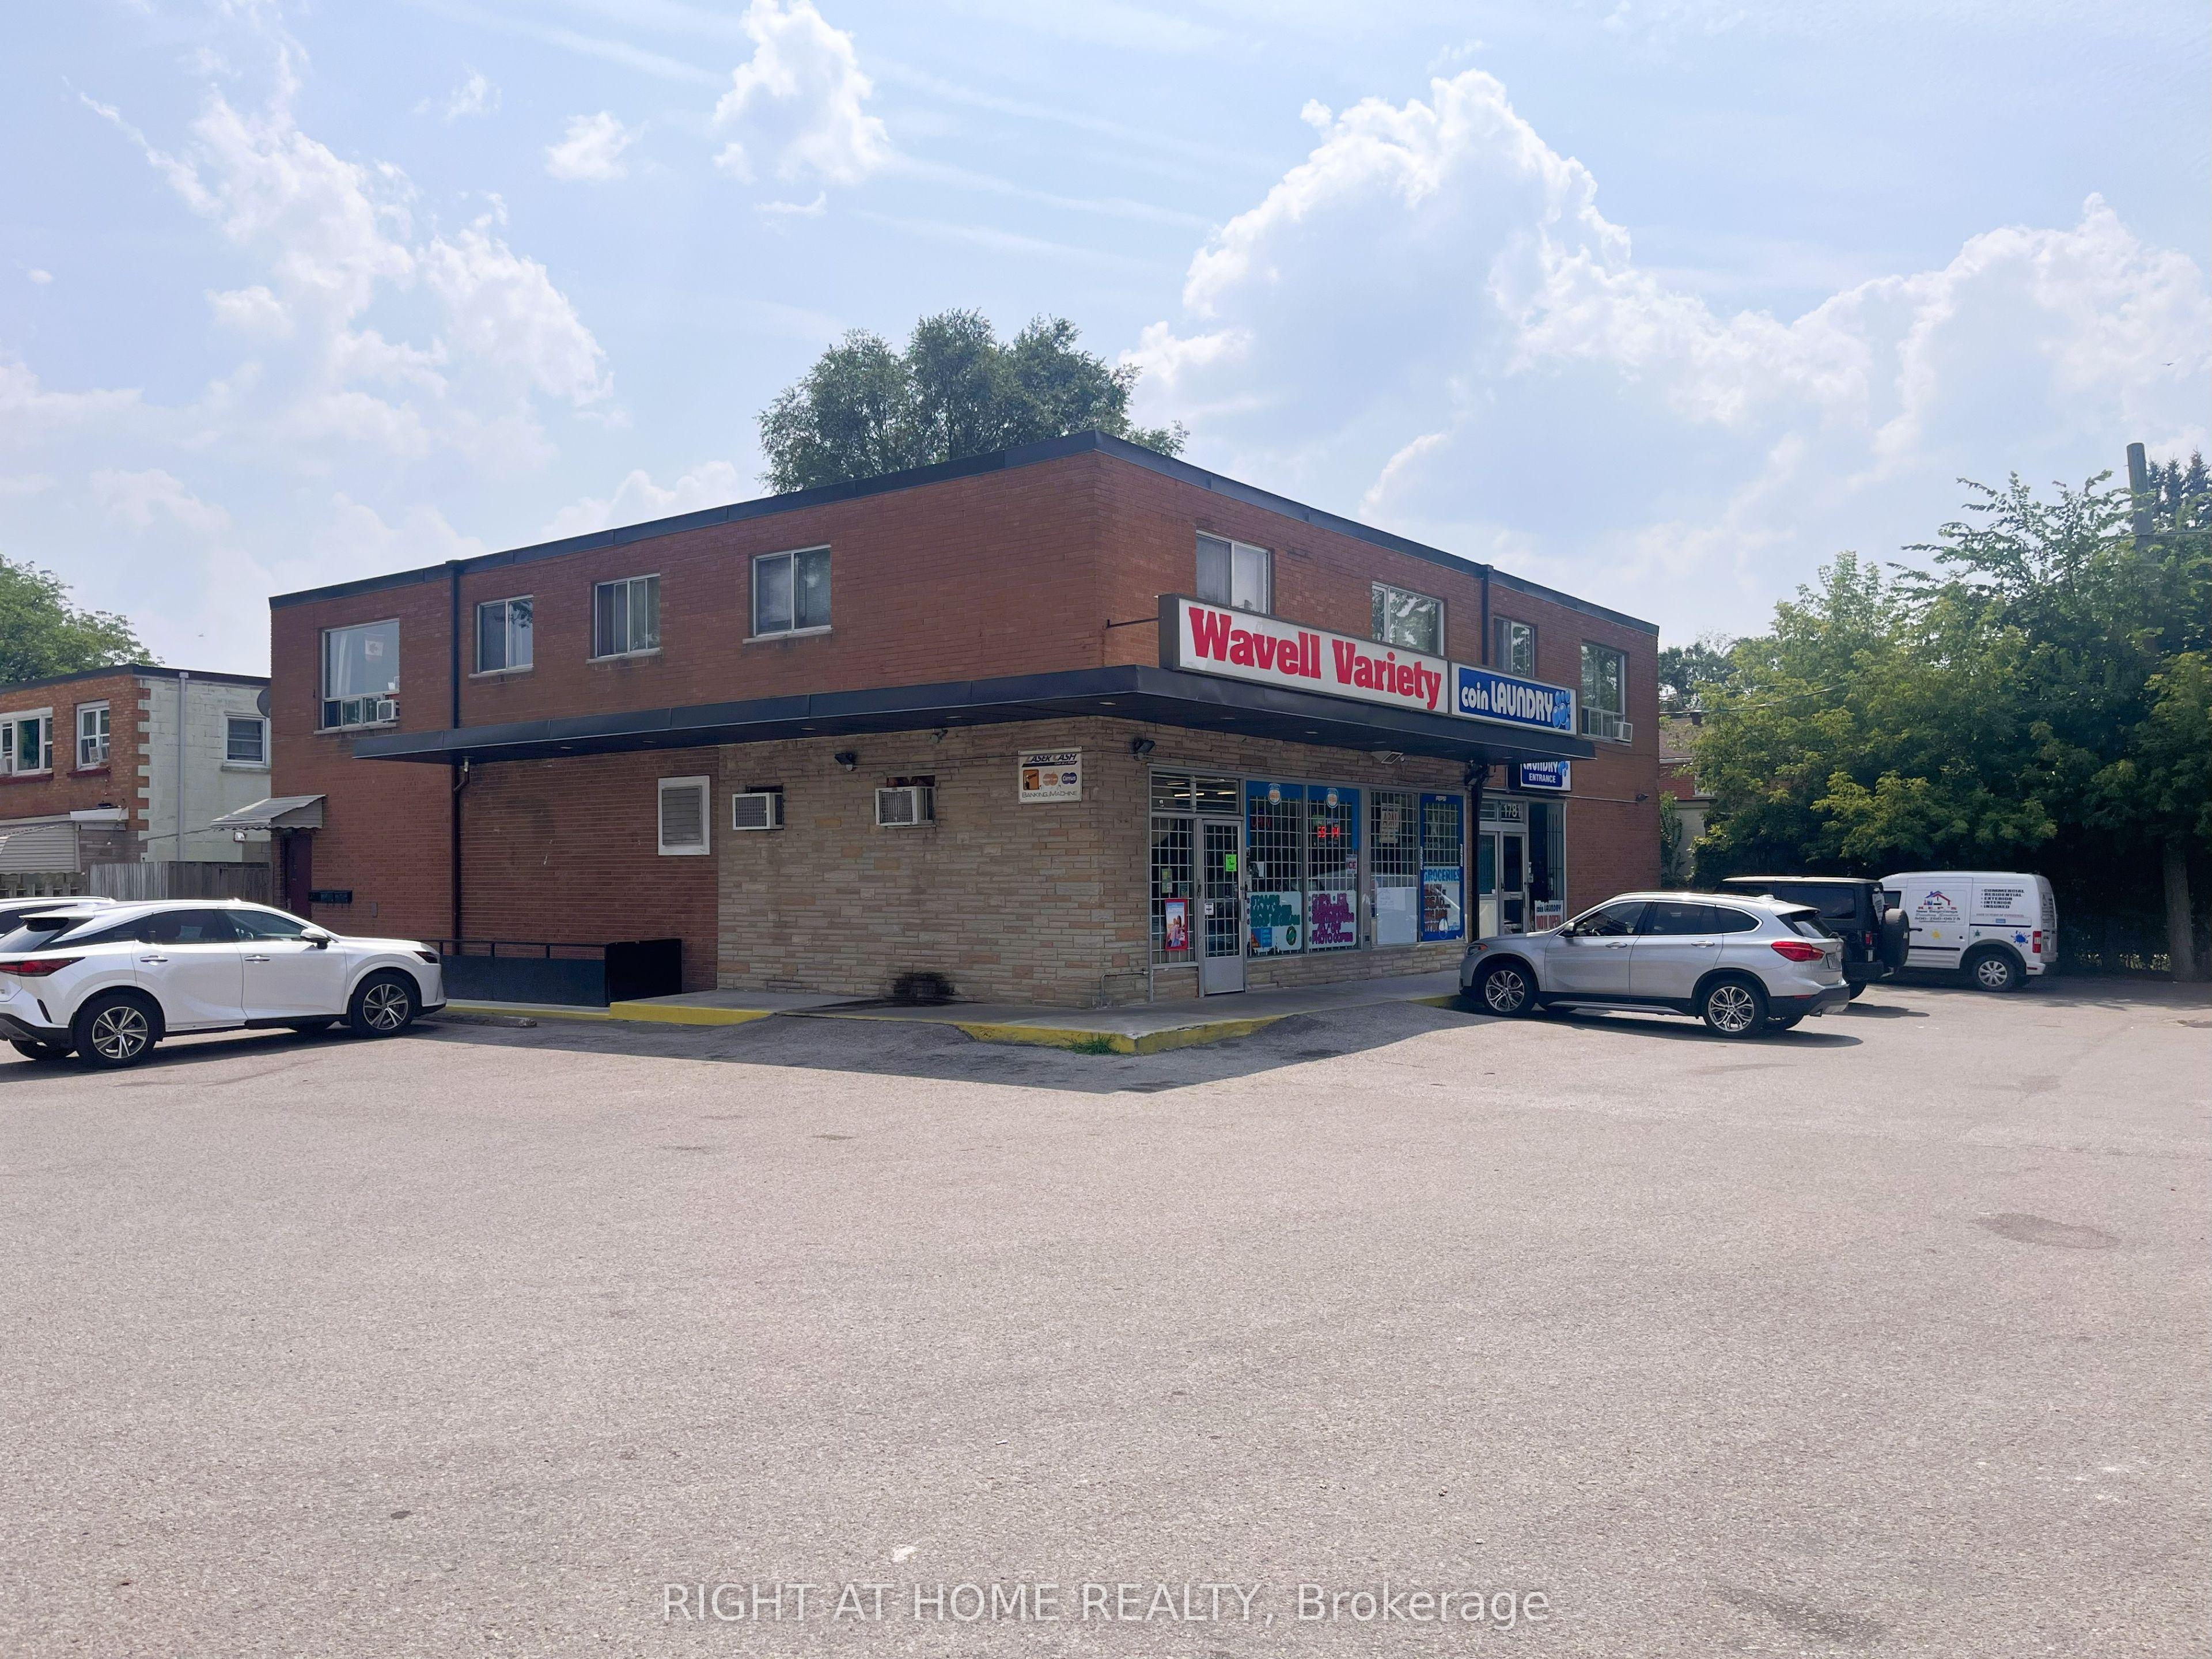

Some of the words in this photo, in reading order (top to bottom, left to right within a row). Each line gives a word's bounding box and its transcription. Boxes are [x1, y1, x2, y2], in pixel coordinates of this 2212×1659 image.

[1188, 607, 1321, 680] Wavell
[1332, 639, 1442, 710] Variety
[1461, 682, 1489, 710] coin
[1490, 680, 1554, 722] LAUNDRY
[1529, 773, 1556, 783] ENTRANCE
[1424, 869, 1460, 881] GROCERIES
